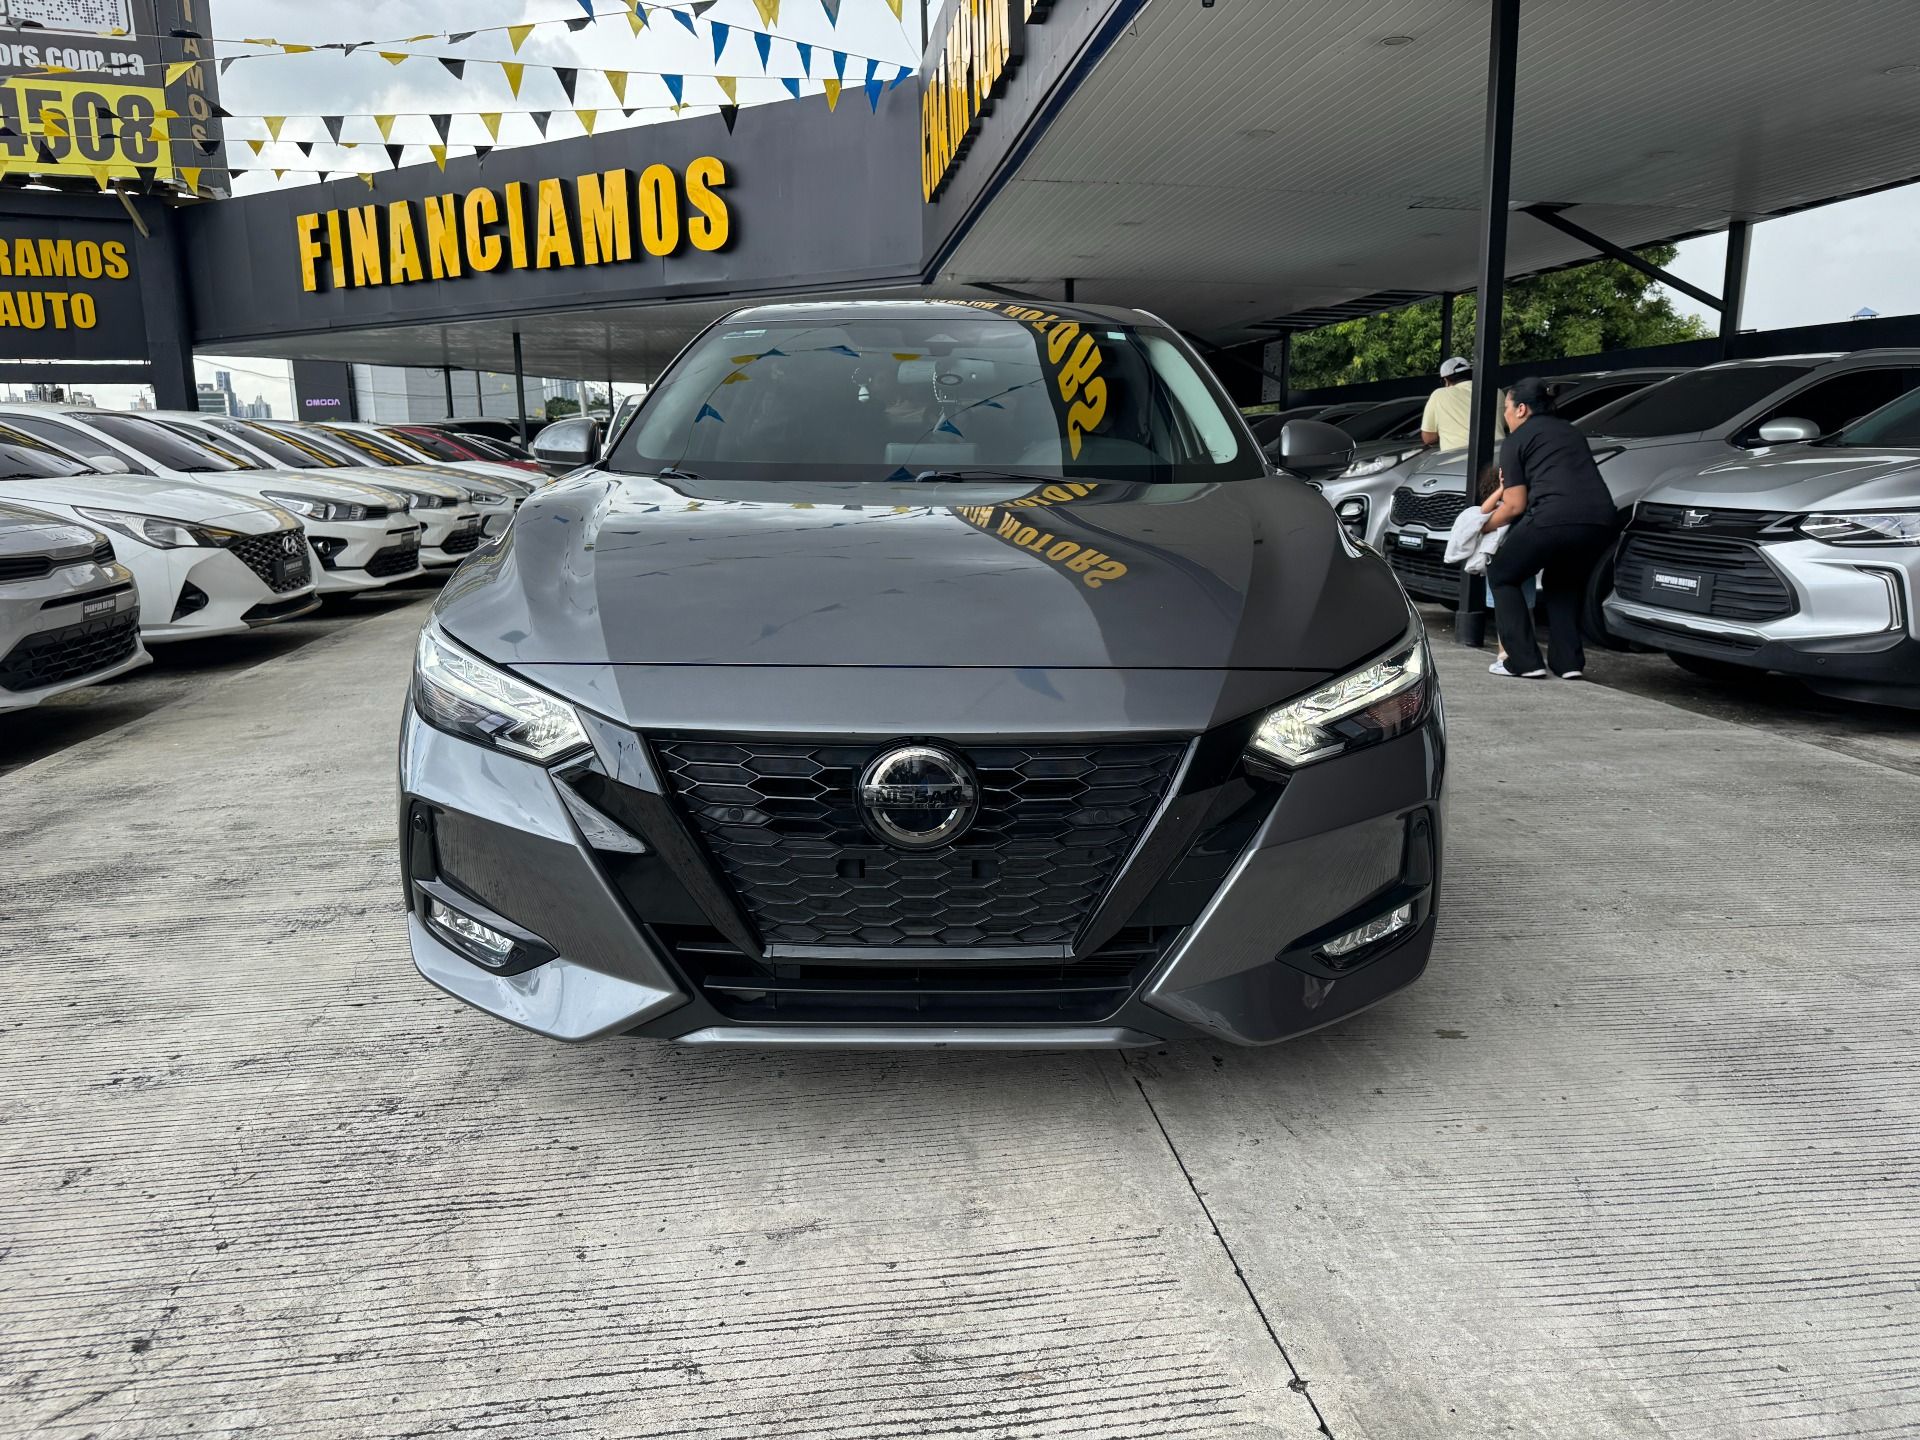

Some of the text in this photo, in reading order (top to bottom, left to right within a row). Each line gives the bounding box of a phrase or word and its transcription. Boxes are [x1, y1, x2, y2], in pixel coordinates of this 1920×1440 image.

[296, 156, 729, 292] FINANCIAMOS
[0, 291, 97, 330] AUTO
[305, 398, 341, 407] OMODA
